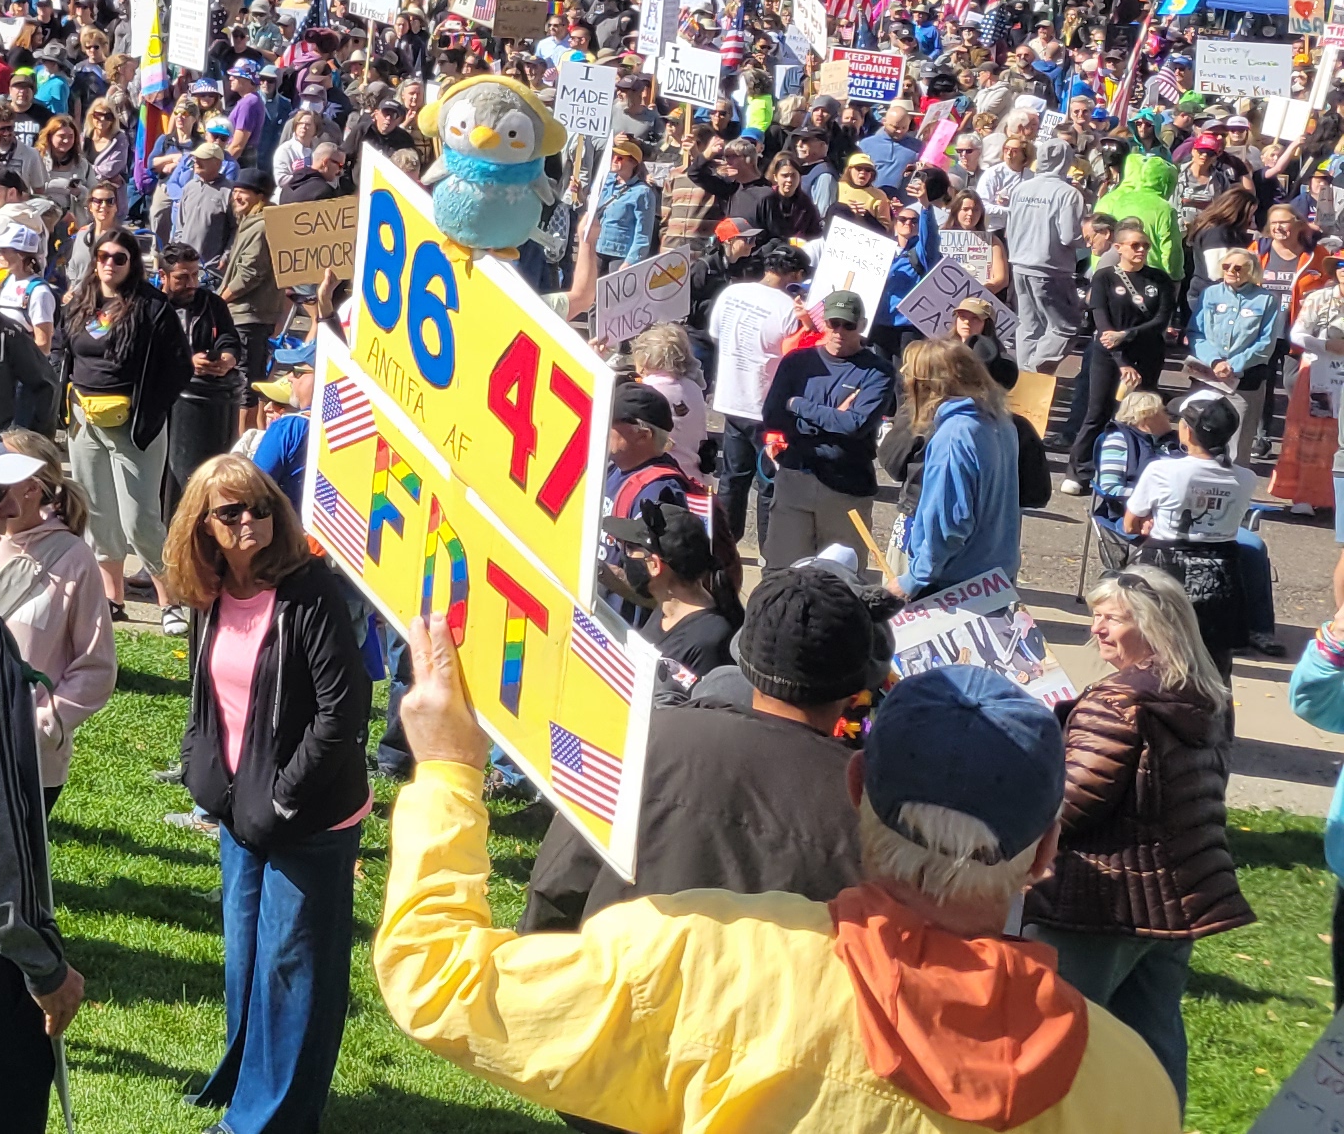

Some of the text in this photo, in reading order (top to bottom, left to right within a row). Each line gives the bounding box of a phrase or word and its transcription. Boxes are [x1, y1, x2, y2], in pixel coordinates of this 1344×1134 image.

[1291, 17, 1325, 33] USA
[670, 46, 681, 64] I
[844, 51, 892, 65] KEEP THE
[579, 65, 595, 82] I
[849, 62, 900, 76] MIGRANTS
[667, 67, 718, 104] DISSENT!
[848, 77, 876, 89] PORT
[876, 79, 896, 91] THE
[848, 87, 885, 99] ACISTS
[560, 85, 609, 106] MADE
[569, 103, 597, 117] THIS
[14, 120, 40, 134] ustin
[559, 113, 607, 136] SIGN!
[293, 205, 356, 237] SAVE
[277, 241, 353, 274] DEMOCR
[604, 272, 638, 309] NO
[932, 264, 1016, 339] SMSH
[604, 302, 656, 340] KINGS
[363, 189, 593, 519] 86 47
[367, 336, 472, 463] ANTIFA AF
[1195, 496, 1222, 511] DEI
[367, 438, 548, 718] FDT
